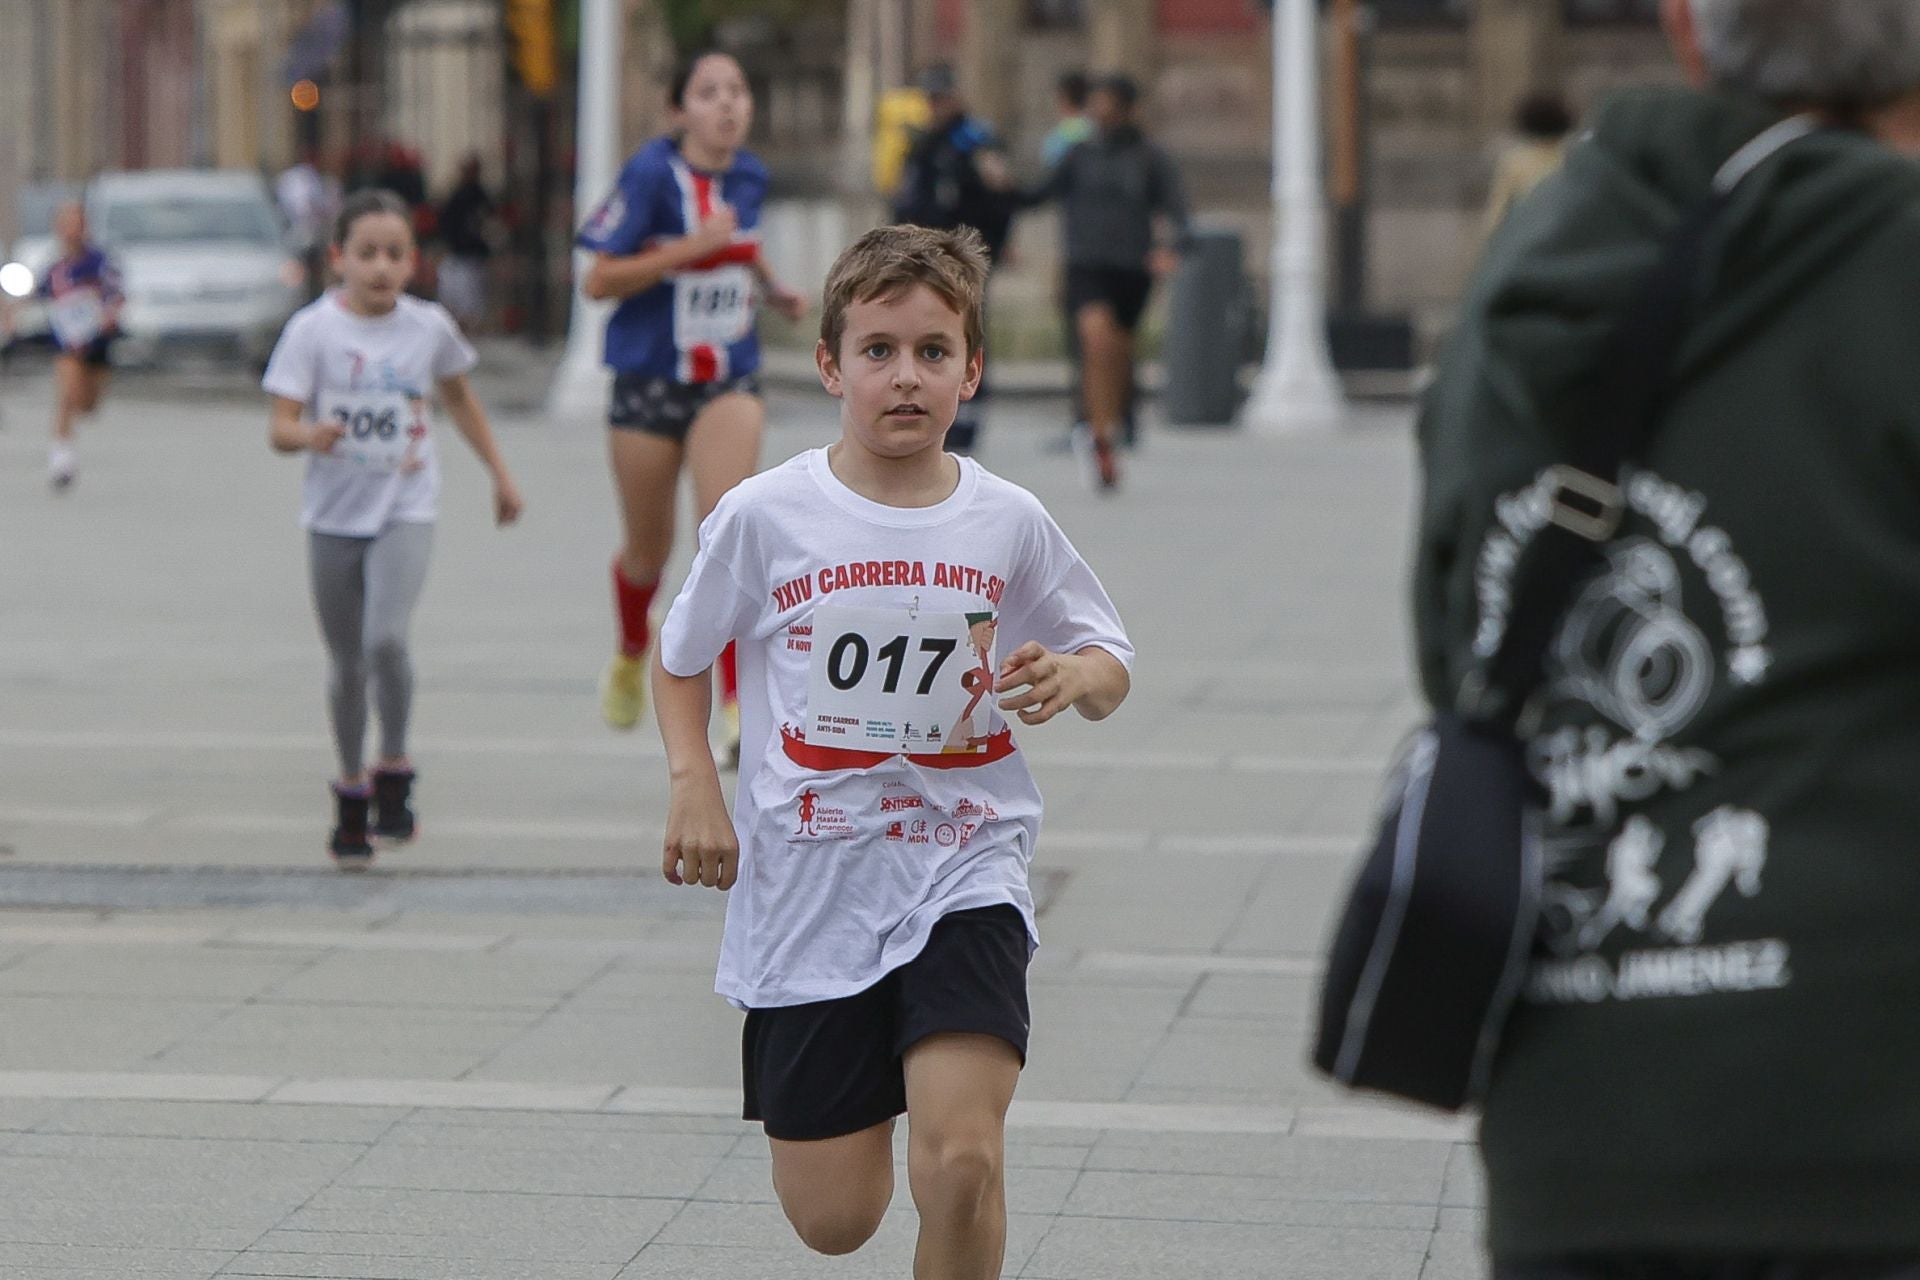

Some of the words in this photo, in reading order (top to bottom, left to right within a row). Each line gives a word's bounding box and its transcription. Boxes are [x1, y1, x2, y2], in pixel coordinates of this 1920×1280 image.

[772, 574, 812, 615] XXIV
[818, 560, 926, 595] CARRERA
[827, 631, 958, 695] 017
[833, 716, 860, 726] CARRERA
[816, 725, 846, 734] ANTI-SIDA
[816, 807, 844, 815] Abierto
[839, 815, 847, 823] el
[816, 824, 854, 832] Amanecer
